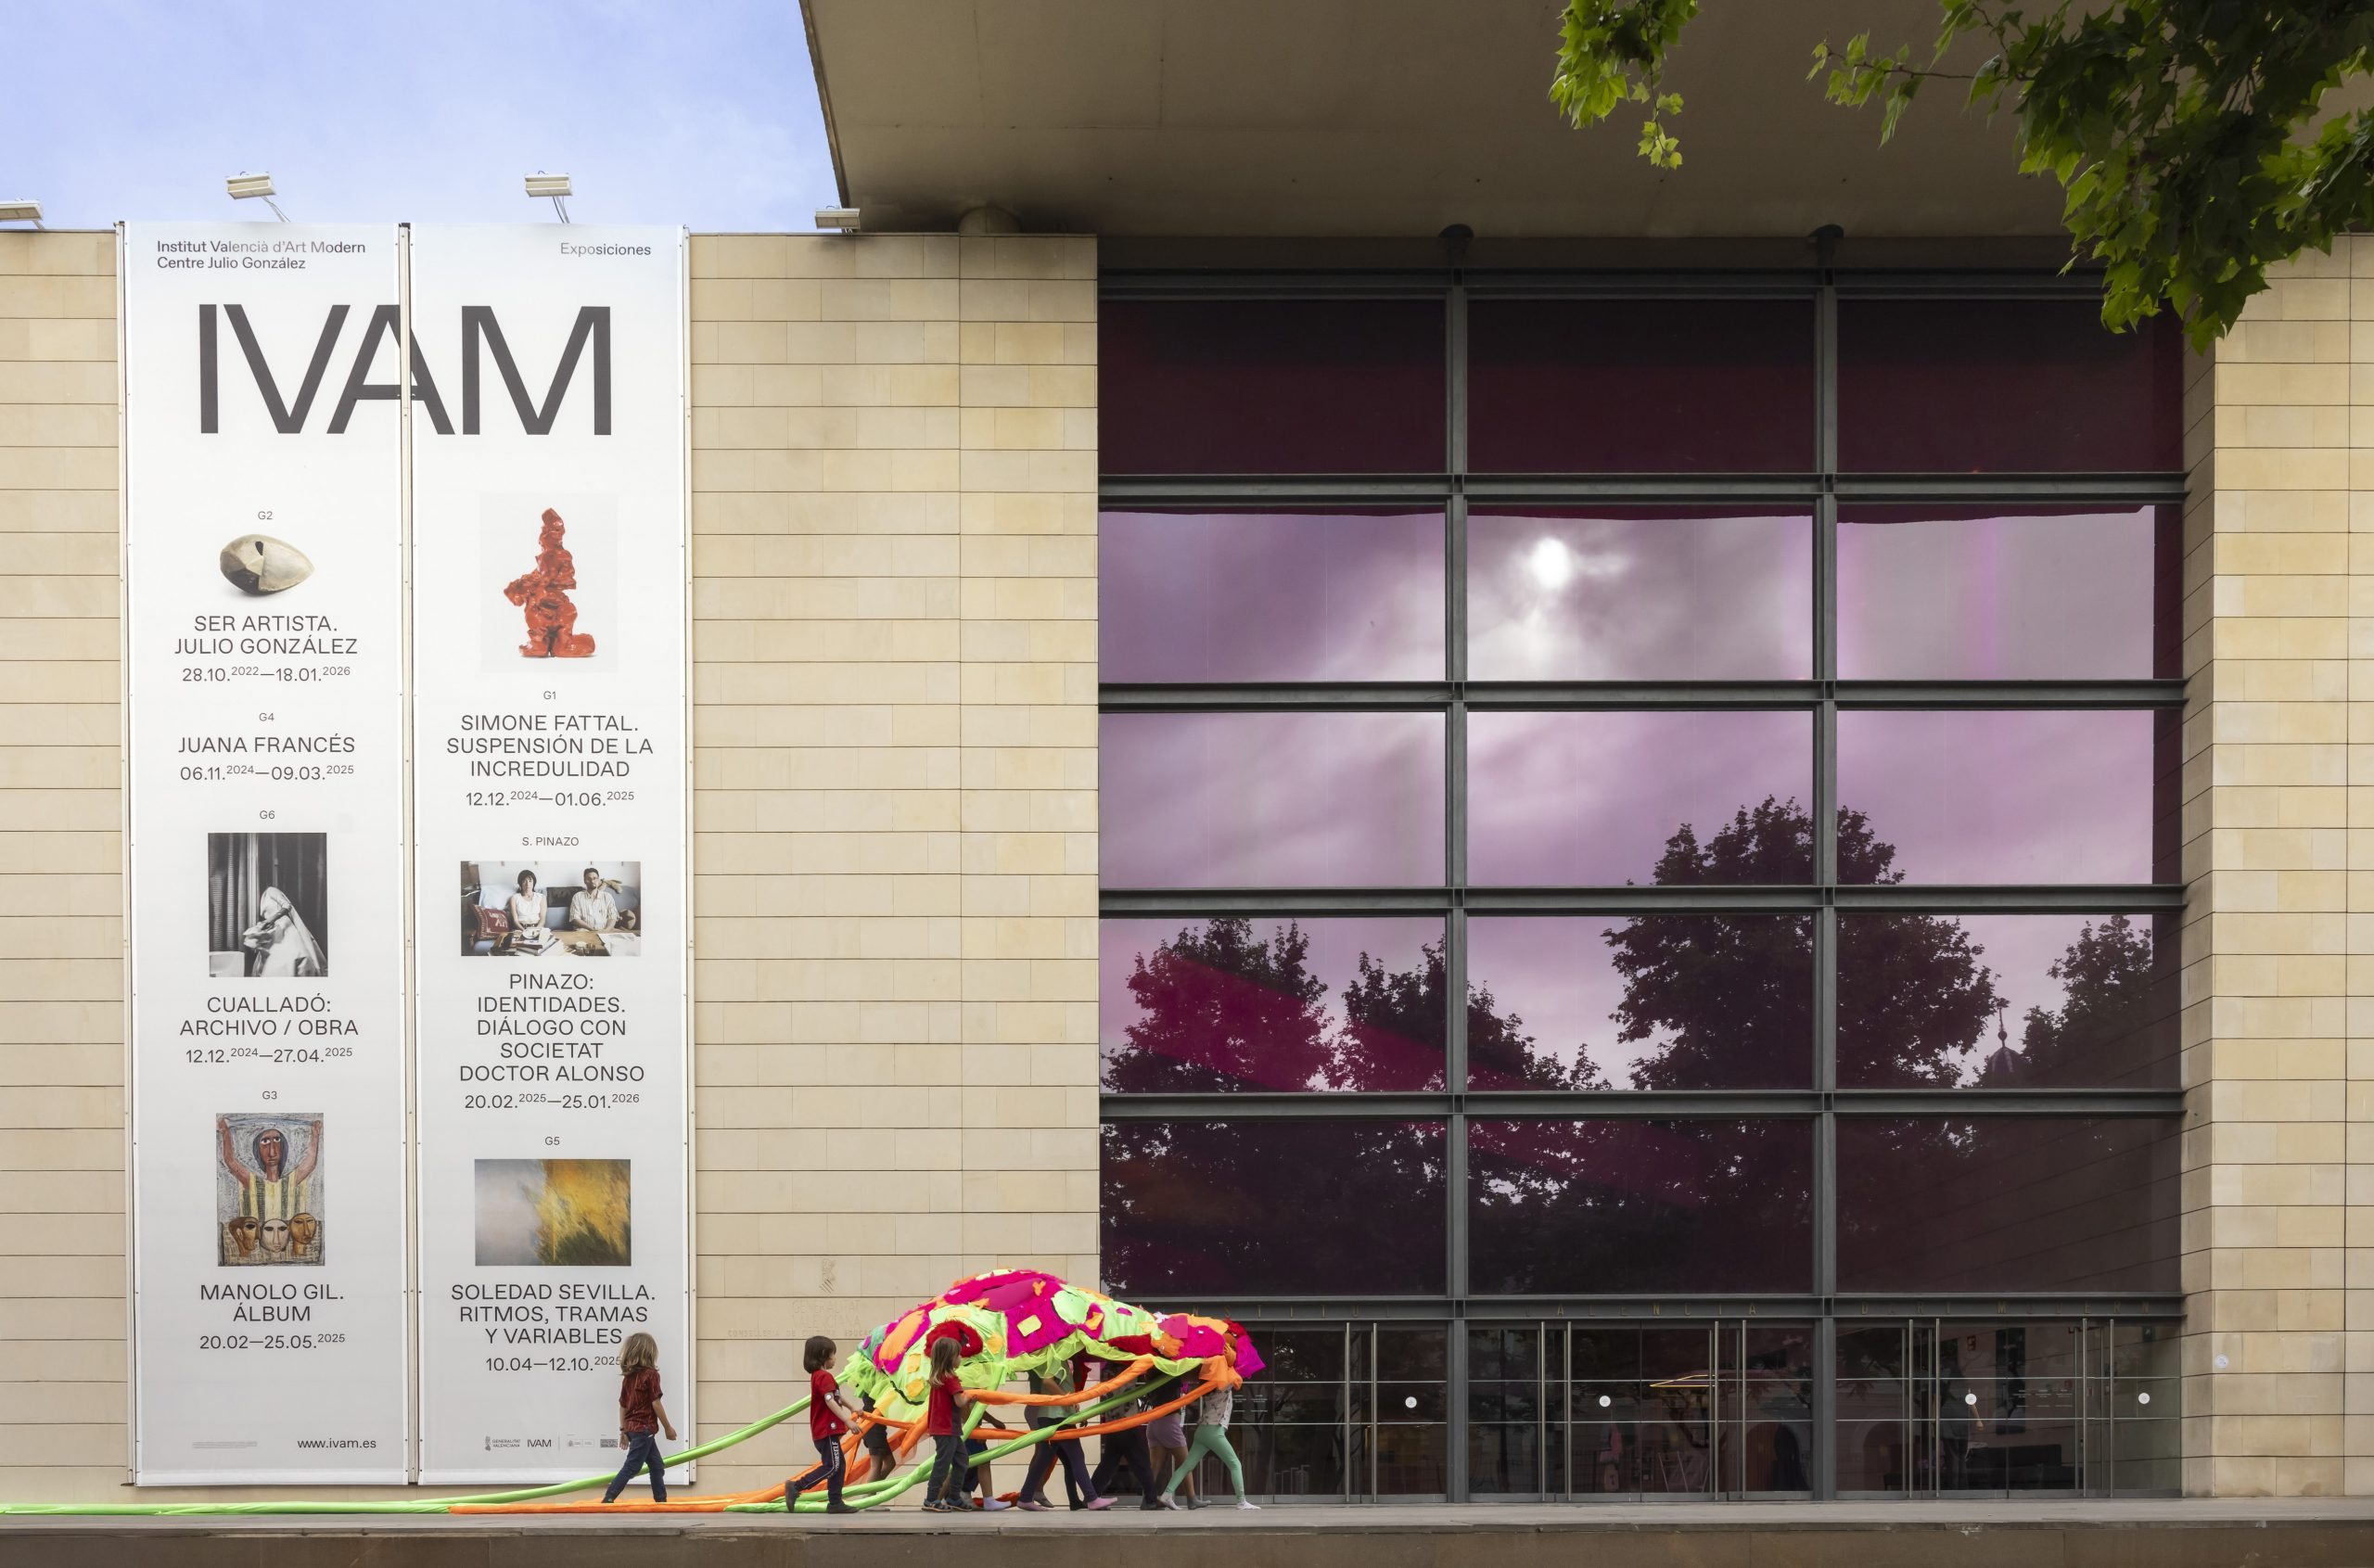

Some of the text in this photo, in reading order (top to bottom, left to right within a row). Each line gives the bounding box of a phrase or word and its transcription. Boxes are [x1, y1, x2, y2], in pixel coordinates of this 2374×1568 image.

[157, 240, 208, 253] Institut
[210, 240, 269, 253] Valencià
[311, 240, 366, 254] Modern
[560, 242, 652, 258] Exposiciones
[157, 256, 306, 270] Centre Julio González
[198, 303, 612, 436] IVAM
[257, 510, 274, 520] G2
[194, 615, 338, 632] SER ARTISTA.
[174, 634, 358, 655] JULIO GONZÁLEZ
[542, 690, 556, 700] G1
[259, 712, 275, 722] G4
[461, 714, 639, 732] SIMONE FATTAL.
[177, 733, 355, 754] JUANA FRANCÉS
[446, 733, 654, 755] SUSPENSIÓN DE LA
[471, 760, 630, 777] INCREDULIDAD
[259, 809, 275, 820] G6
[521, 836, 580, 847] S. PINAZO
[509, 973, 594, 990] PINAZO:
[207, 992, 331, 1013] CUALLADÓ:
[478, 996, 626, 1013] IDENTIDADES.
[179, 1019, 277, 1036] ARCHIVO
[298, 1019, 359, 1036] OBRA
[478, 1015, 626, 1036] DIÁLOGO CON
[500, 1041, 605, 1059] SOCIETAT
[460, 1064, 645, 1082] DOCTOR ALONSO
[262, 1090, 277, 1101] G3
[544, 1136, 560, 1146] G5
[200, 1283, 344, 1301] MANOLO GIL.
[451, 1283, 656, 1301] SOLEDAD SEVILLA.
[233, 1302, 311, 1322] ÁLBUM
[460, 1306, 648, 1325] RITMOS, TRAMAS
[484, 1328, 622, 1345] Y VARIABLES
[297, 1437, 377, 1448] www.ivam.es
[527, 1438, 552, 1447] IVAM
